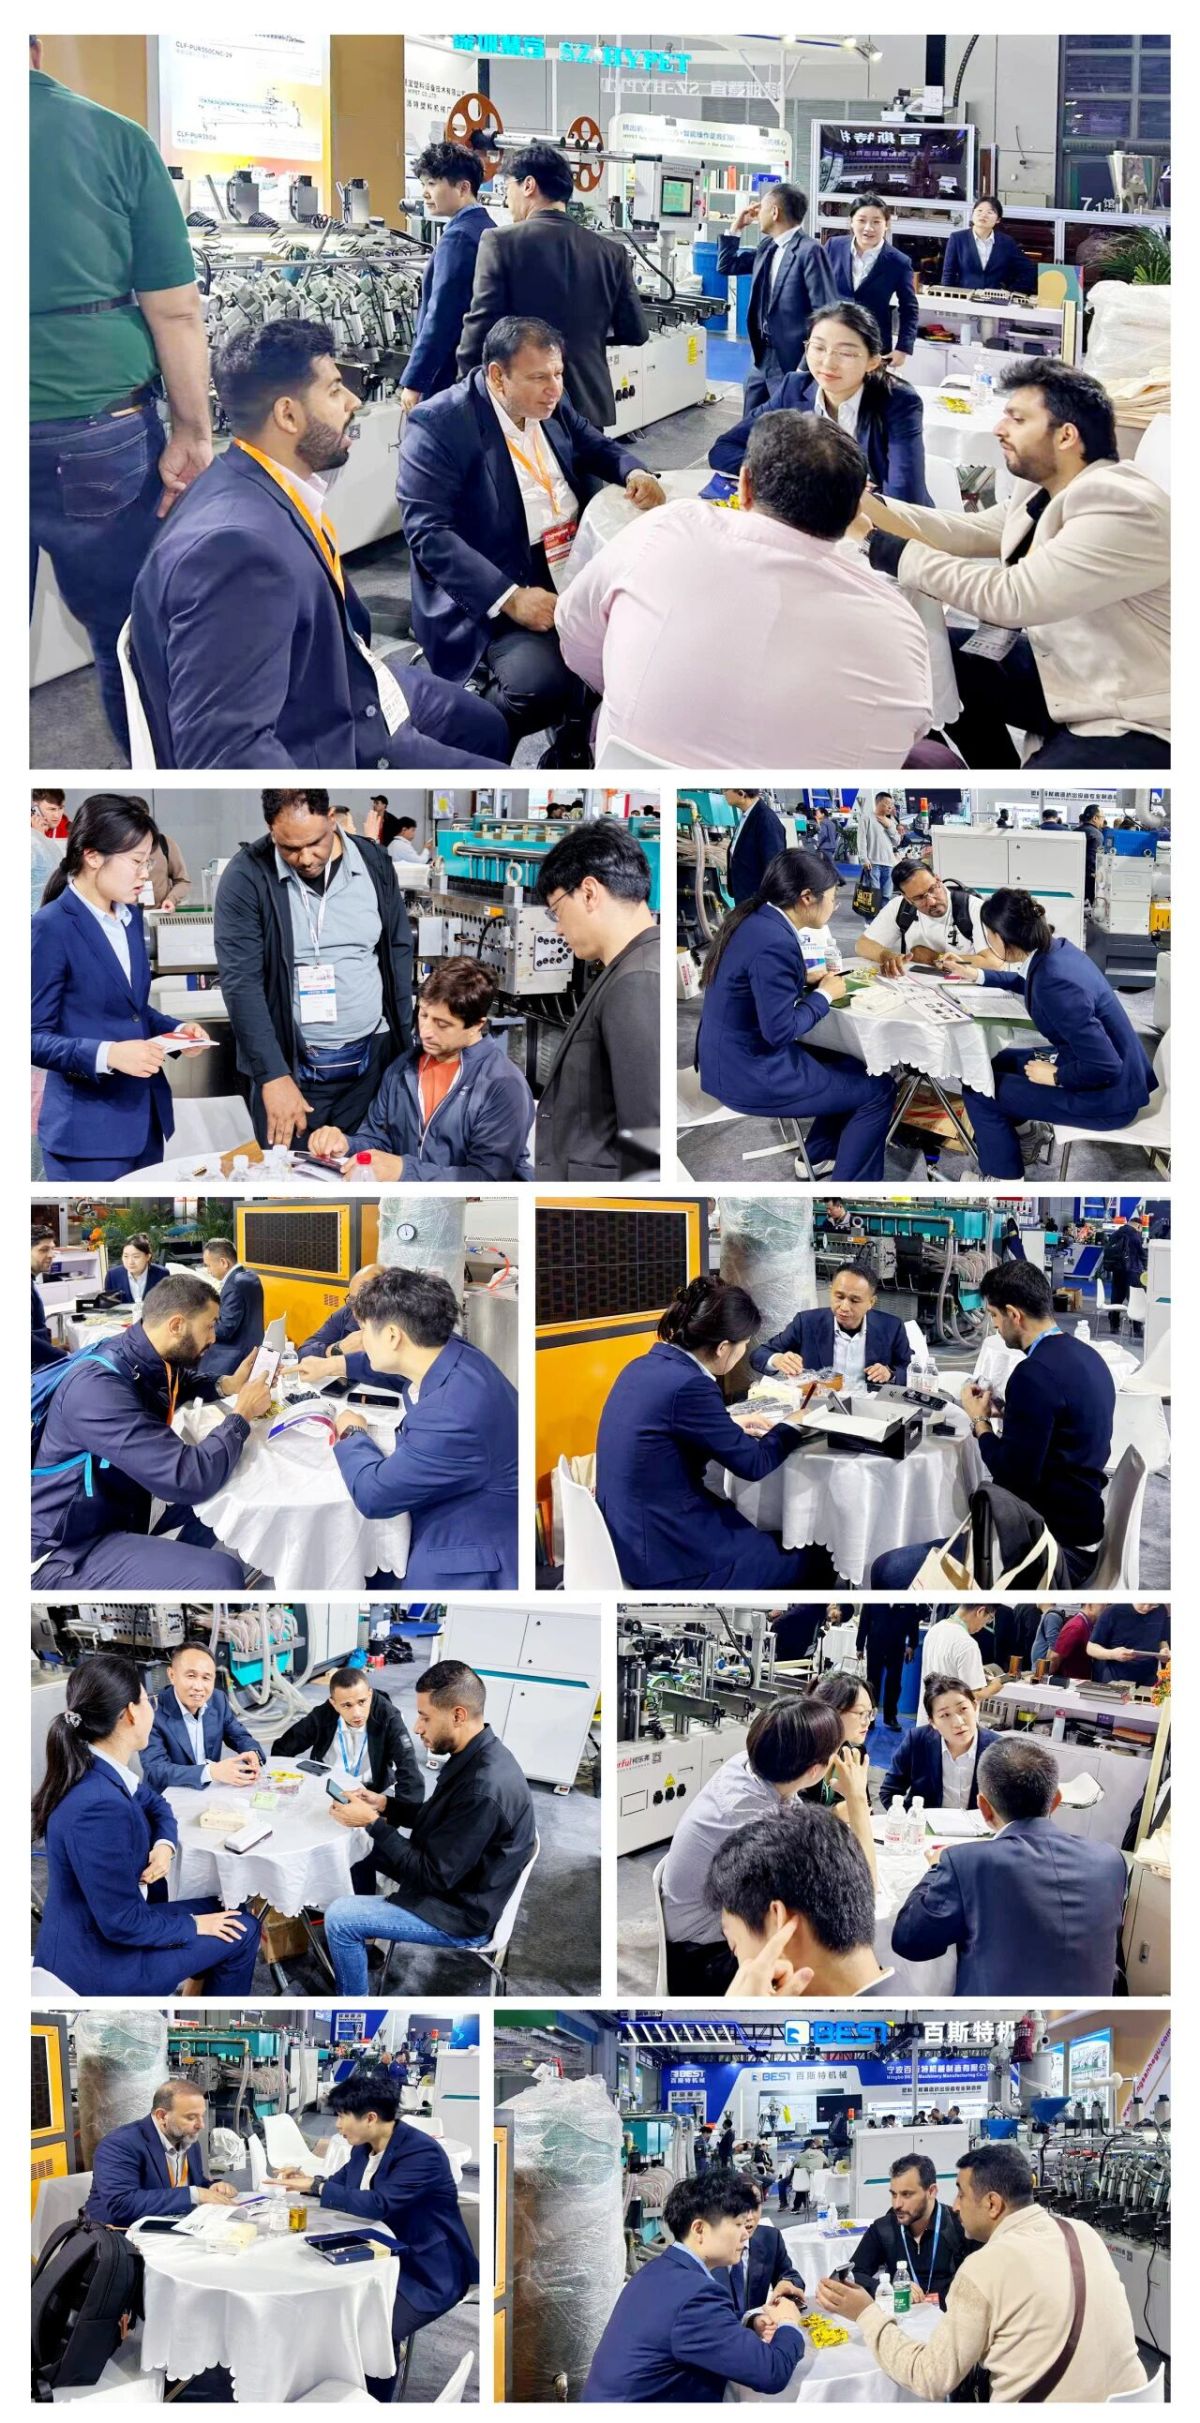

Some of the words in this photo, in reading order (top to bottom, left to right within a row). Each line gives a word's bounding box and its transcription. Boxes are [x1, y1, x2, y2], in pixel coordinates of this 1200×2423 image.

[559, 42, 691, 74] SZHYPET
[813, 2020, 895, 2047] BEST
[680, 2070, 705, 2078] BEST
[762, 2072, 791, 2081] BEST
